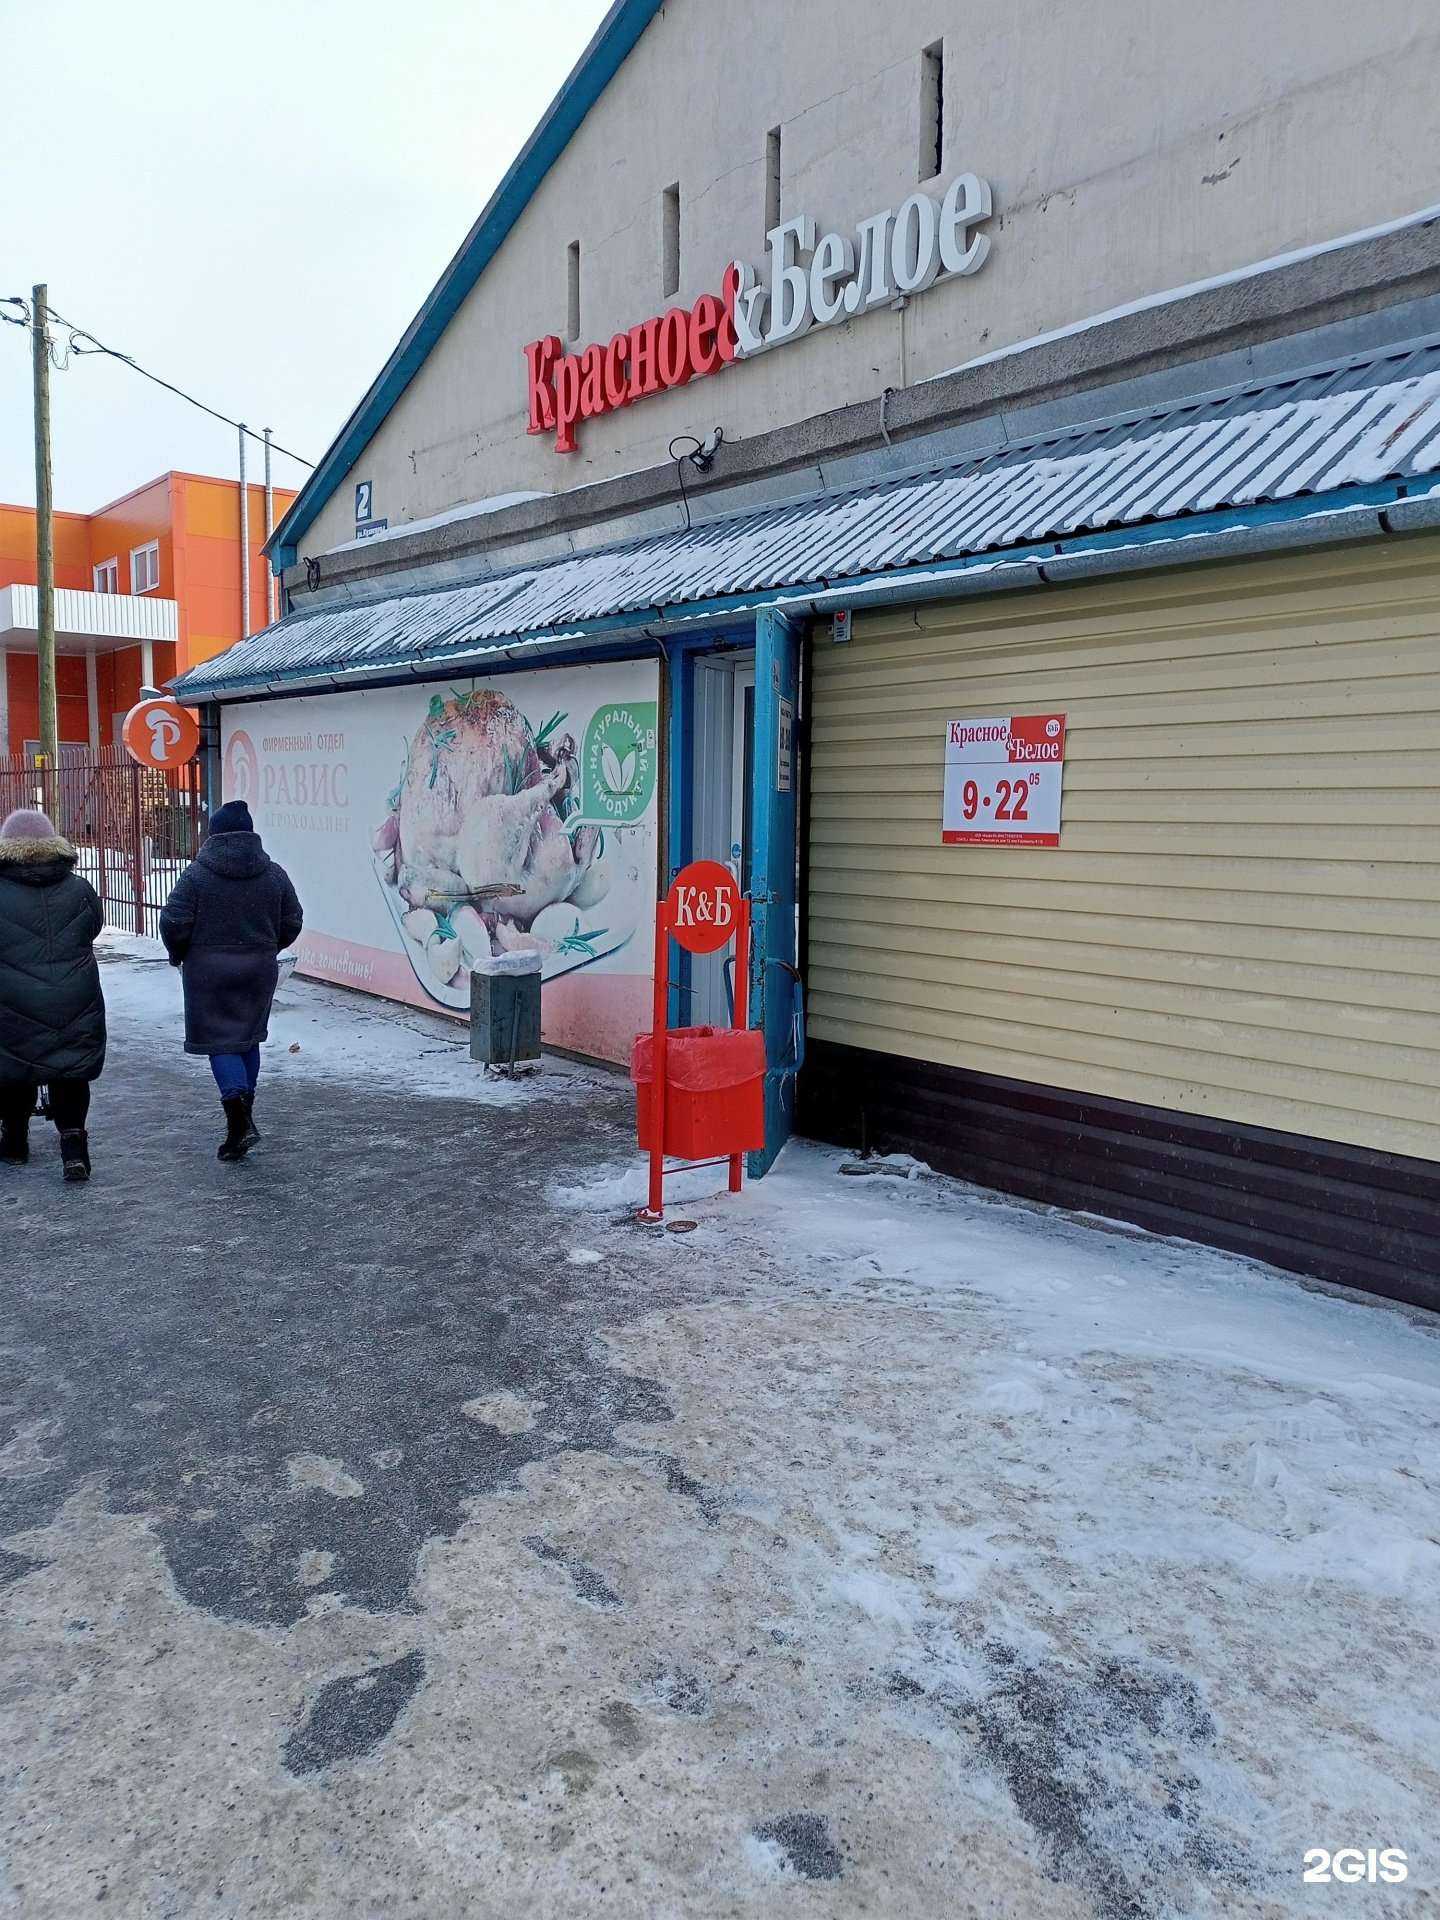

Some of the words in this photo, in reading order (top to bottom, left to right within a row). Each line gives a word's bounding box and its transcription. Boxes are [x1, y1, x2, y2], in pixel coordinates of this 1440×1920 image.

[357, 484, 370, 518] 2
[262, 732, 313, 752] ФИРМЕННЫЙ
[317, 733, 344, 752] ОТДЕЛ
[263, 763, 349, 807] РАВИС
[674, 886, 732, 926] К&Б
